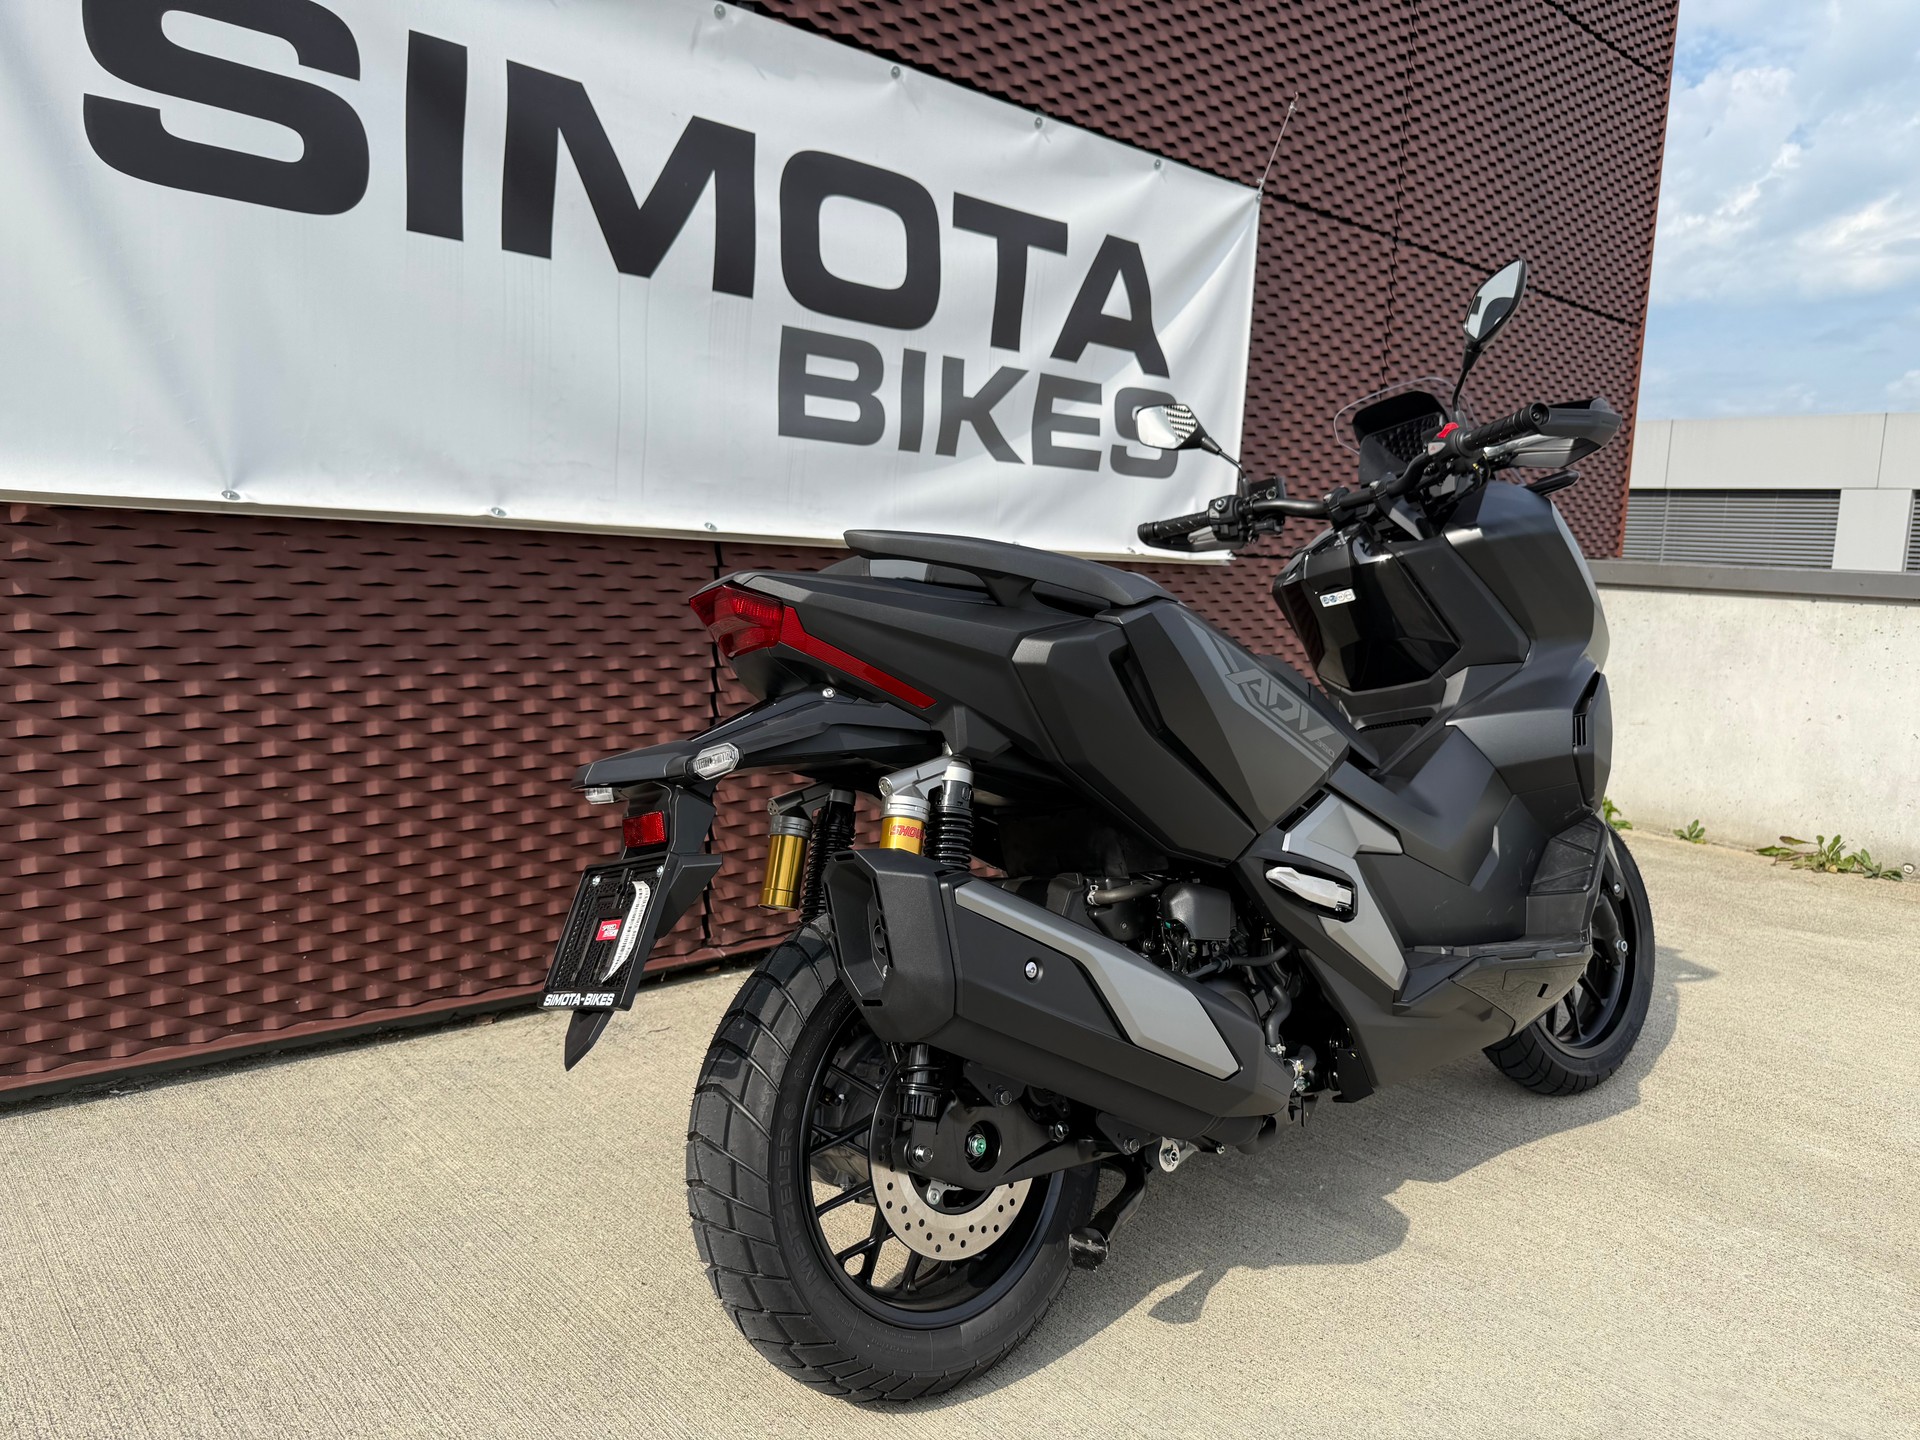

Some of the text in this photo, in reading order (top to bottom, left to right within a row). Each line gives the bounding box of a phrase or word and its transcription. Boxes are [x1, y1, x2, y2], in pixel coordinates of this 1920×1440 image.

[82, 0, 1170, 379] SIMOTA
[778, 325, 1179, 479] BIKES
[1225, 668, 1335, 742] ADV
[543, 992, 615, 1006] SIMOTA-BIKES
[779, 1127, 818, 1286] METZELER
